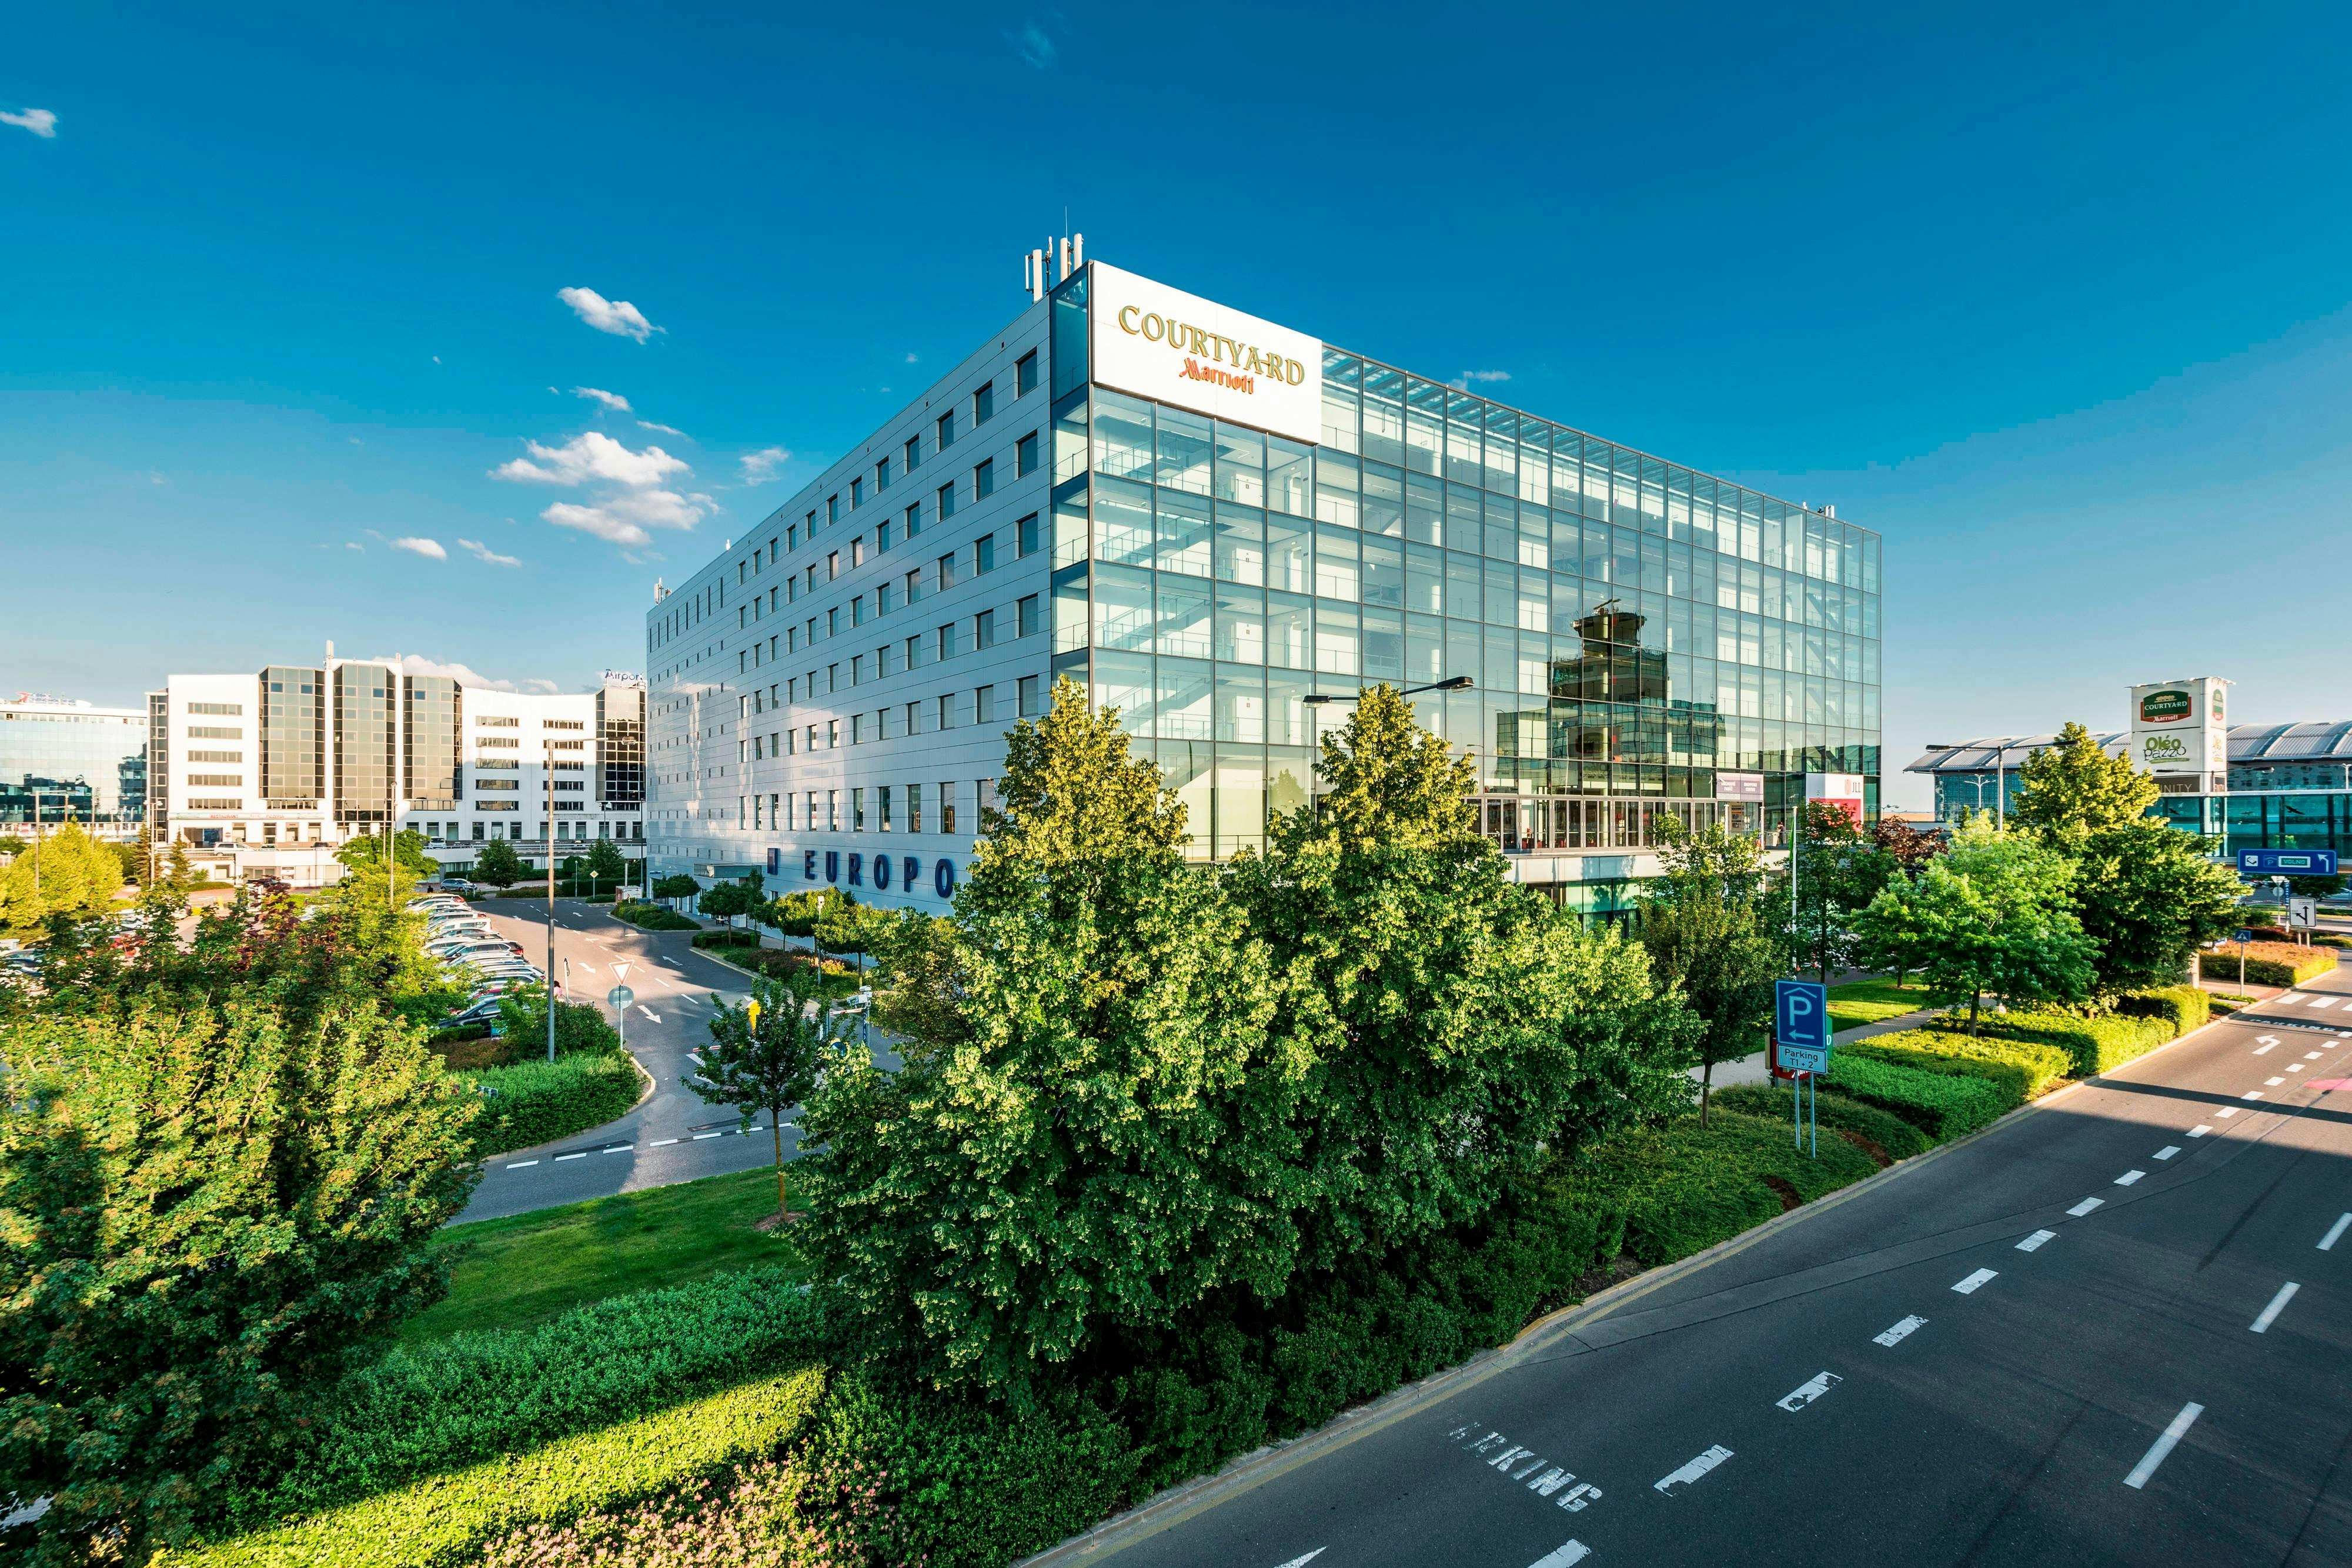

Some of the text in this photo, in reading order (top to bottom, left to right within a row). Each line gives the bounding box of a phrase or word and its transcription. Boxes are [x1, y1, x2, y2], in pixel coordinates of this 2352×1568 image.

[1118, 305, 1305, 386] COURTYARD
[1179, 357, 1254, 394] Marriott
[605, 669, 644, 681] Airport
[2144, 701, 2187, 710] COURTYARD
[2145, 735, 2181, 750] Oléo
[1852, 783, 1861, 793] JLL
[804, 849, 978, 898] EUROPO
[1789, 995, 1812, 1026] P
[1785, 1048, 1818, 1062] Parking
[1448, 1421, 1603, 1513] RKING
